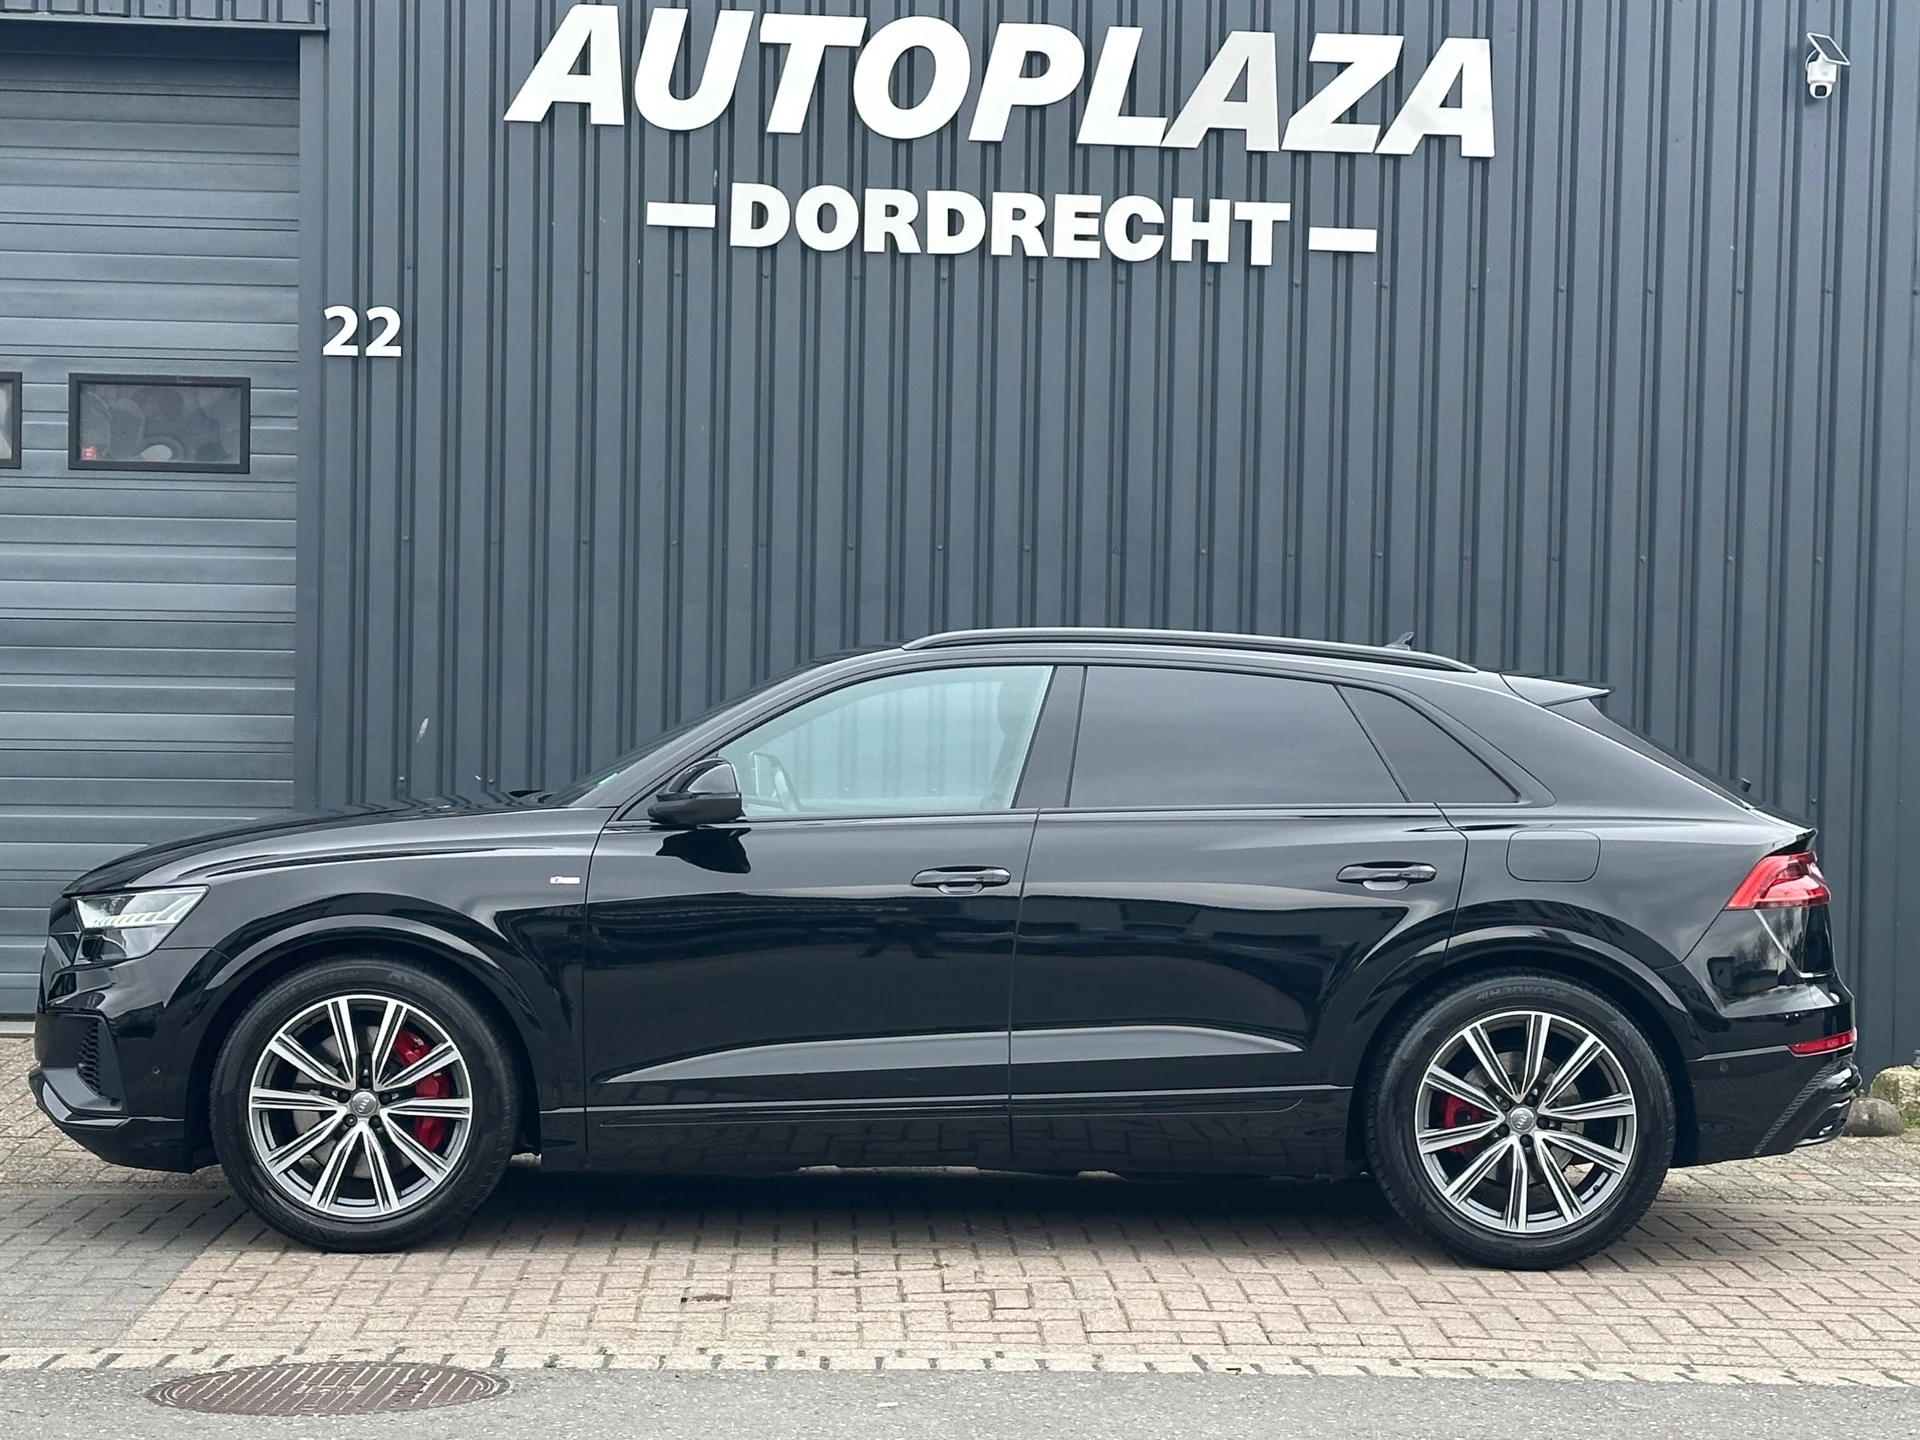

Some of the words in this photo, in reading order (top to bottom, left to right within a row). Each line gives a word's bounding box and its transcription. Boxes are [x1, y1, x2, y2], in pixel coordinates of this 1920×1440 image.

[503, 4, 1496, 160] AUTOPLAZA
[730, 182, 1292, 267] DORDRECHT
[322, 305, 402, 357] 22
